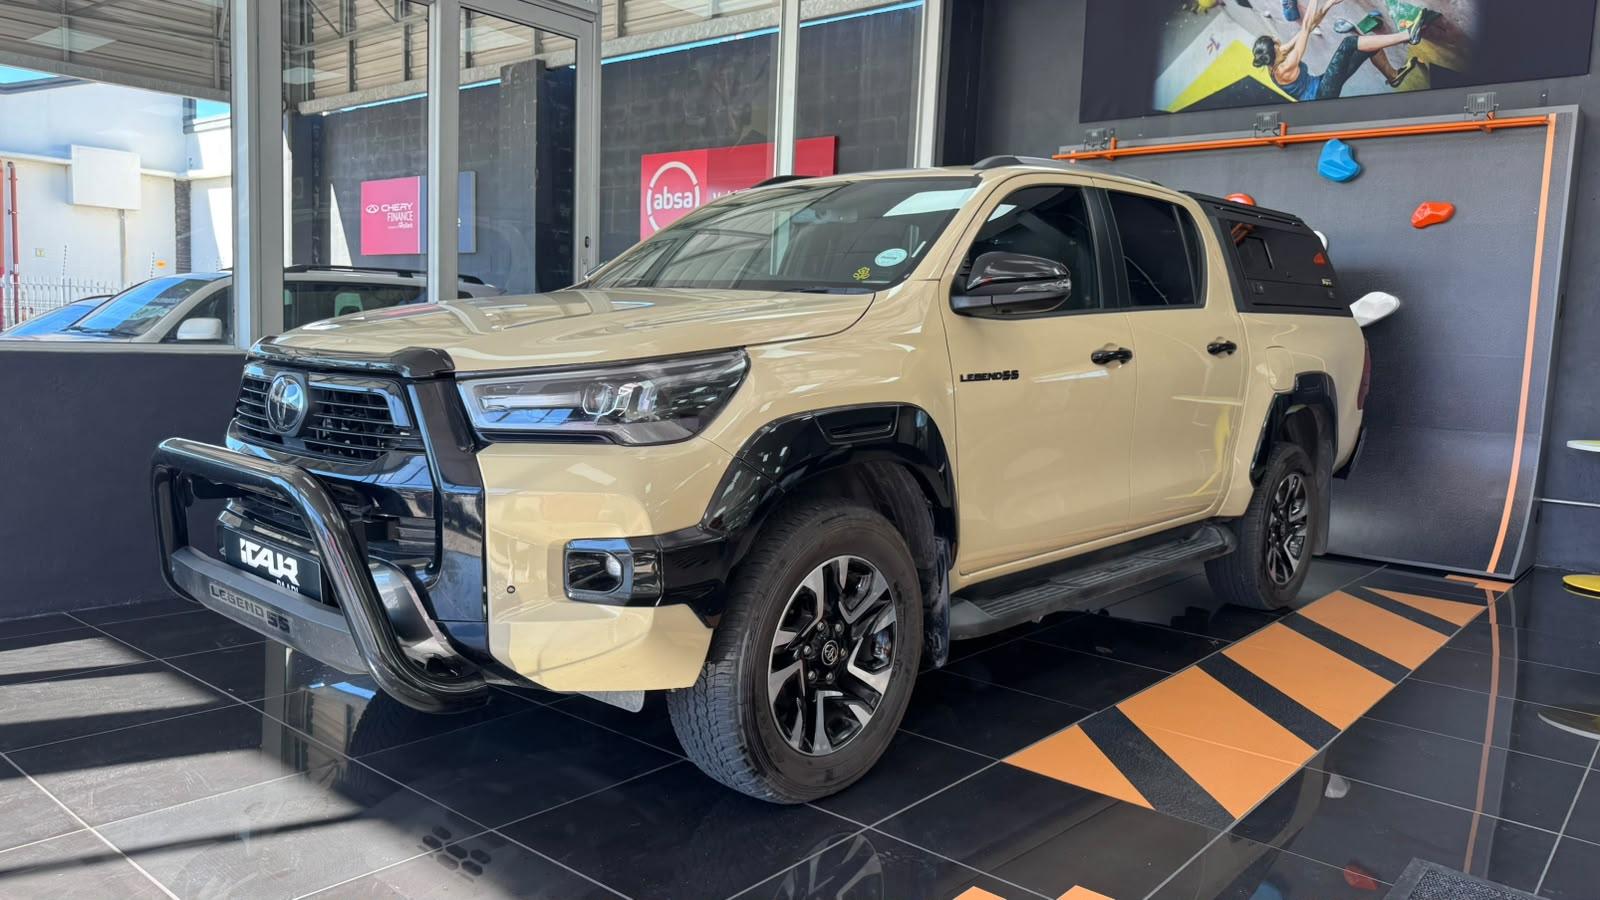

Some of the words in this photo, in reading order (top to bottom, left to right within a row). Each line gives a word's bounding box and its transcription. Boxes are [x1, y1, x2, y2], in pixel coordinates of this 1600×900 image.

[654, 186, 693, 209] absa
[381, 203, 413, 212] CHERY
[387, 212, 413, 222] FINANCE
[210, 584, 264, 618] LEGEND
